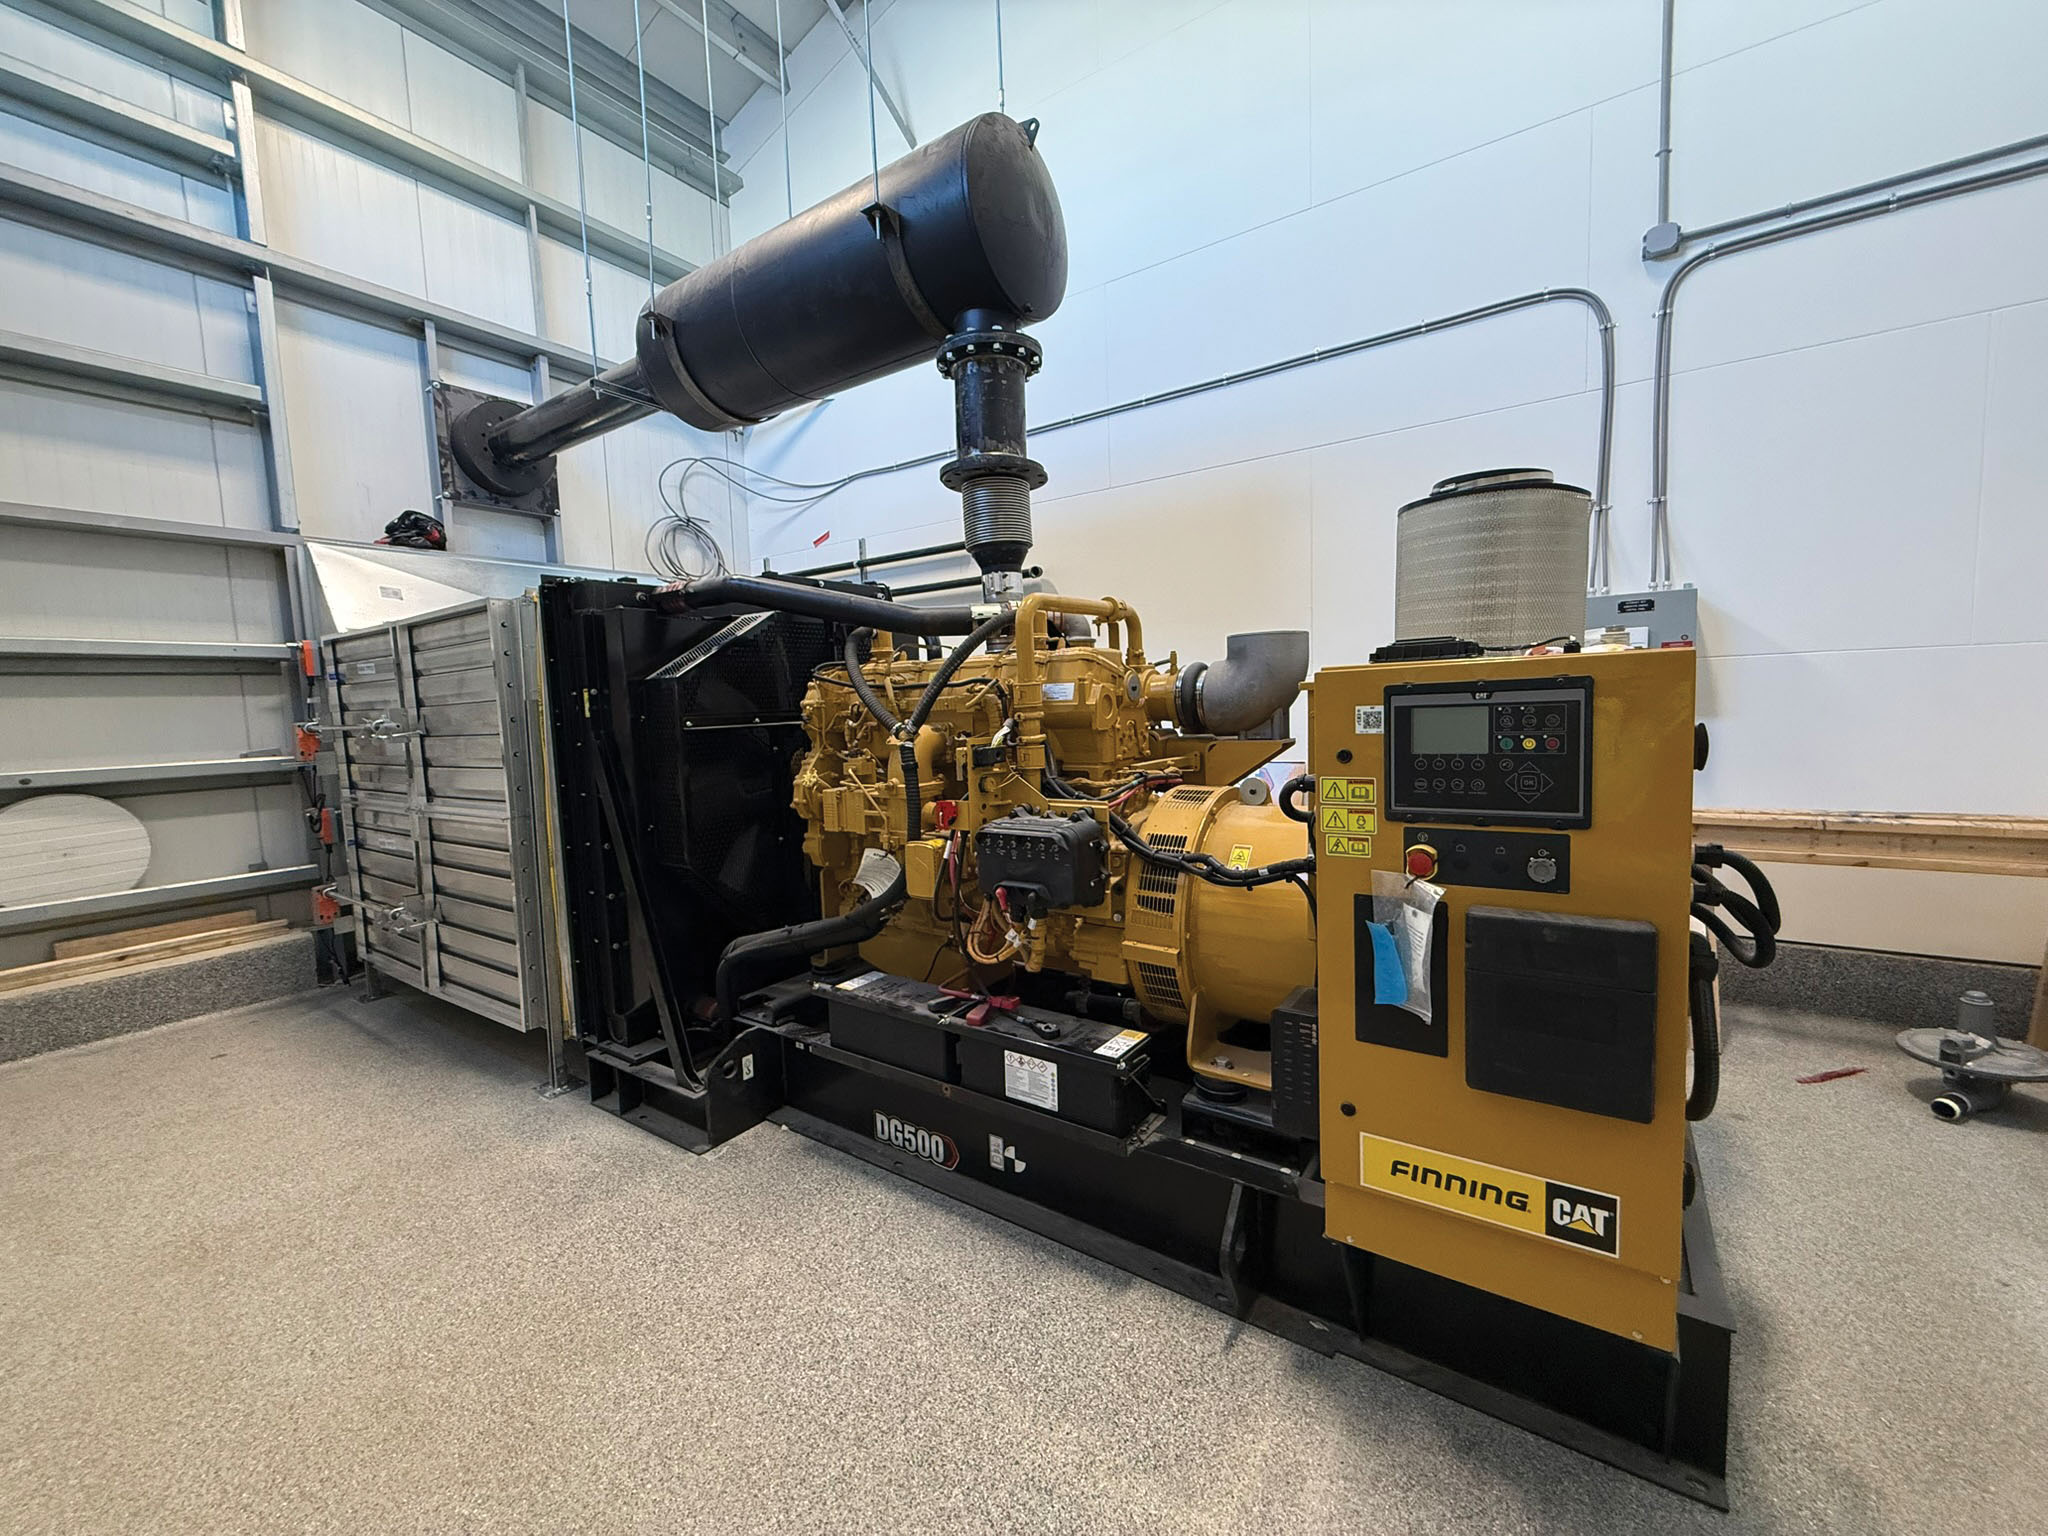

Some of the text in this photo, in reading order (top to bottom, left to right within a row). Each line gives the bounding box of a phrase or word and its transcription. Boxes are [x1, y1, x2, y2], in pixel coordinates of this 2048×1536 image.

[875, 1112, 945, 1163] DG500
[1390, 1159, 1609, 1237] FINNING CAT
